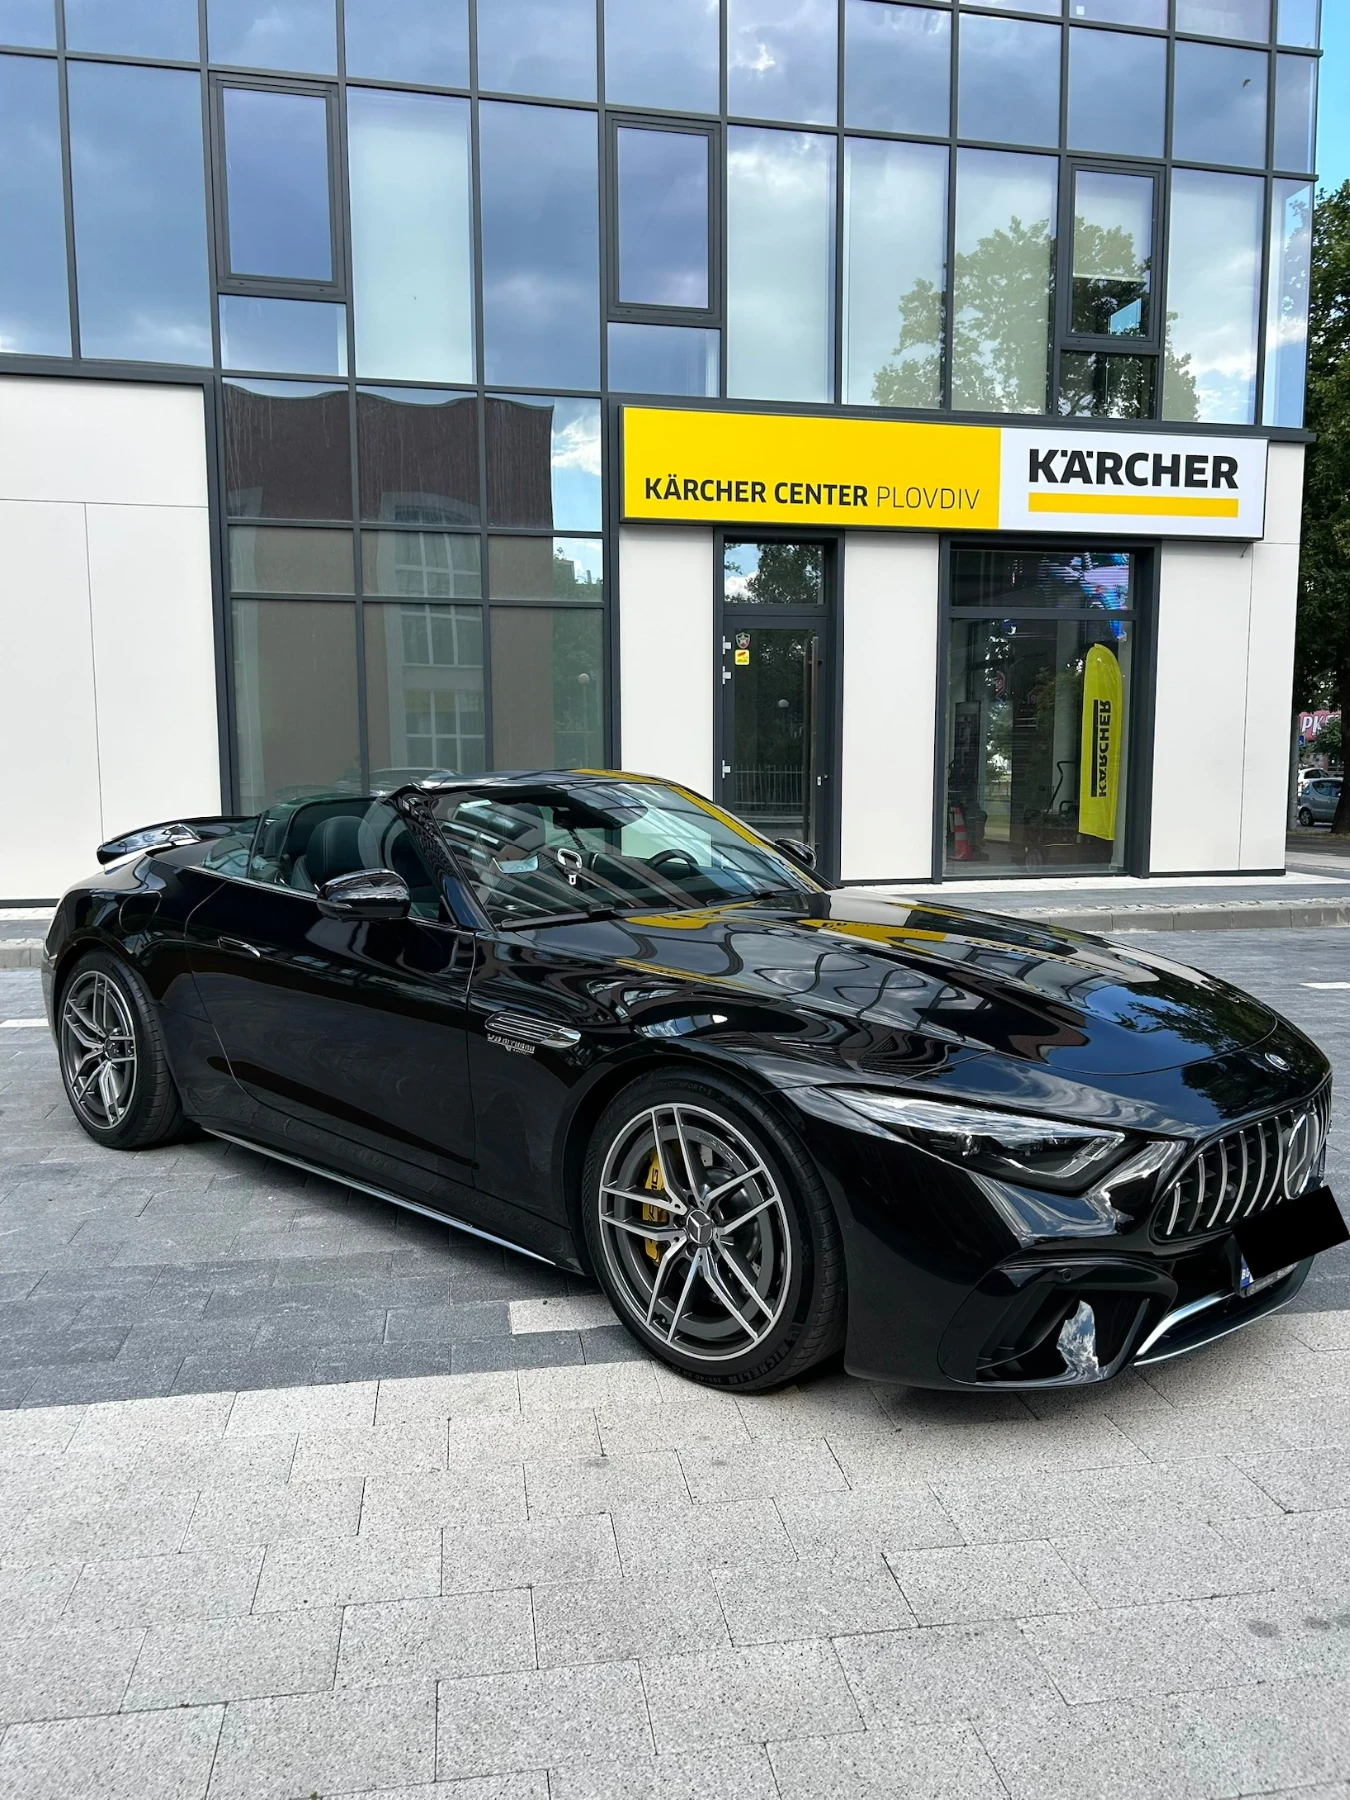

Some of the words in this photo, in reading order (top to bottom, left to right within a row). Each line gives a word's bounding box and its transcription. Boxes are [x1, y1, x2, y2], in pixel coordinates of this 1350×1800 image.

[1029, 449, 1239, 489] KÄRCHER
[645, 474, 766, 503] KÄRCHER
[774, 481, 868, 507] CENTER
[877, 486, 980, 509] PLOVDIV
[727, 1342, 790, 1385] MICHELIN
